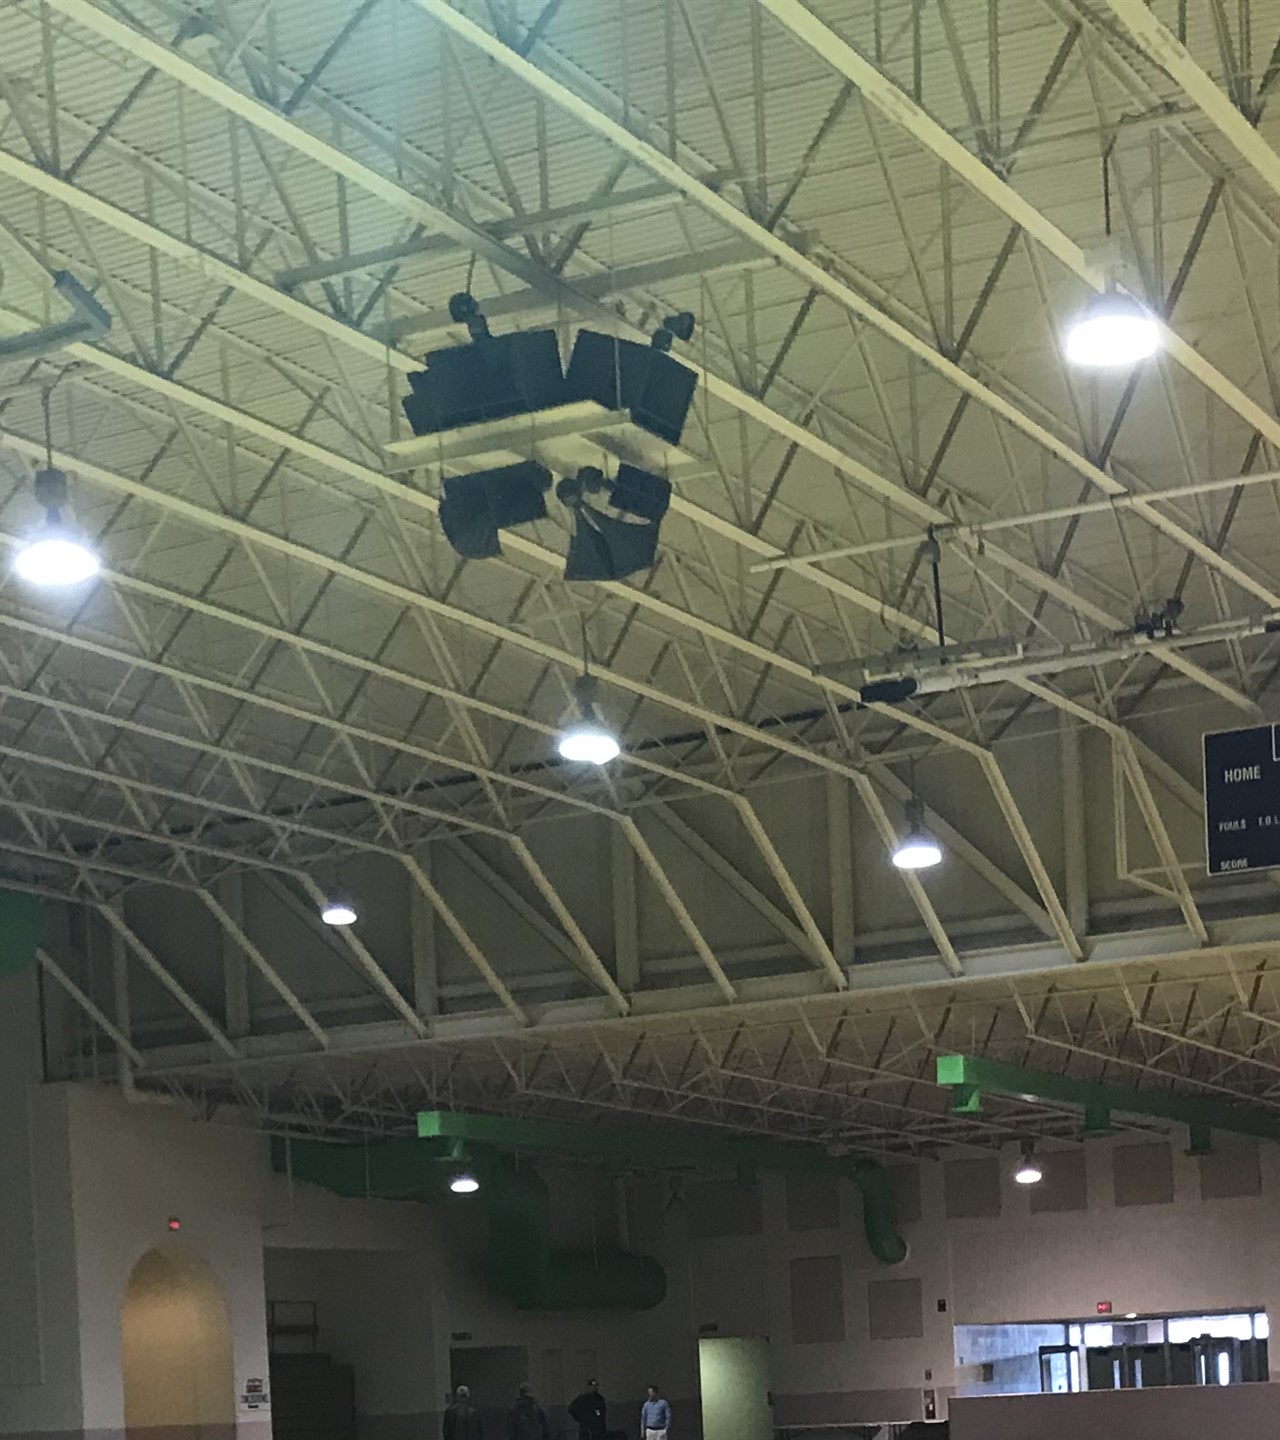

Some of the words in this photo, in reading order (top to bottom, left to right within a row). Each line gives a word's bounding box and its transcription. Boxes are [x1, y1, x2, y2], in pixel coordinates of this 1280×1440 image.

[1224, 765, 1261, 783] HOME
[1219, 819, 1247, 832] FOULS
[1220, 858, 1248, 871] SCORE
